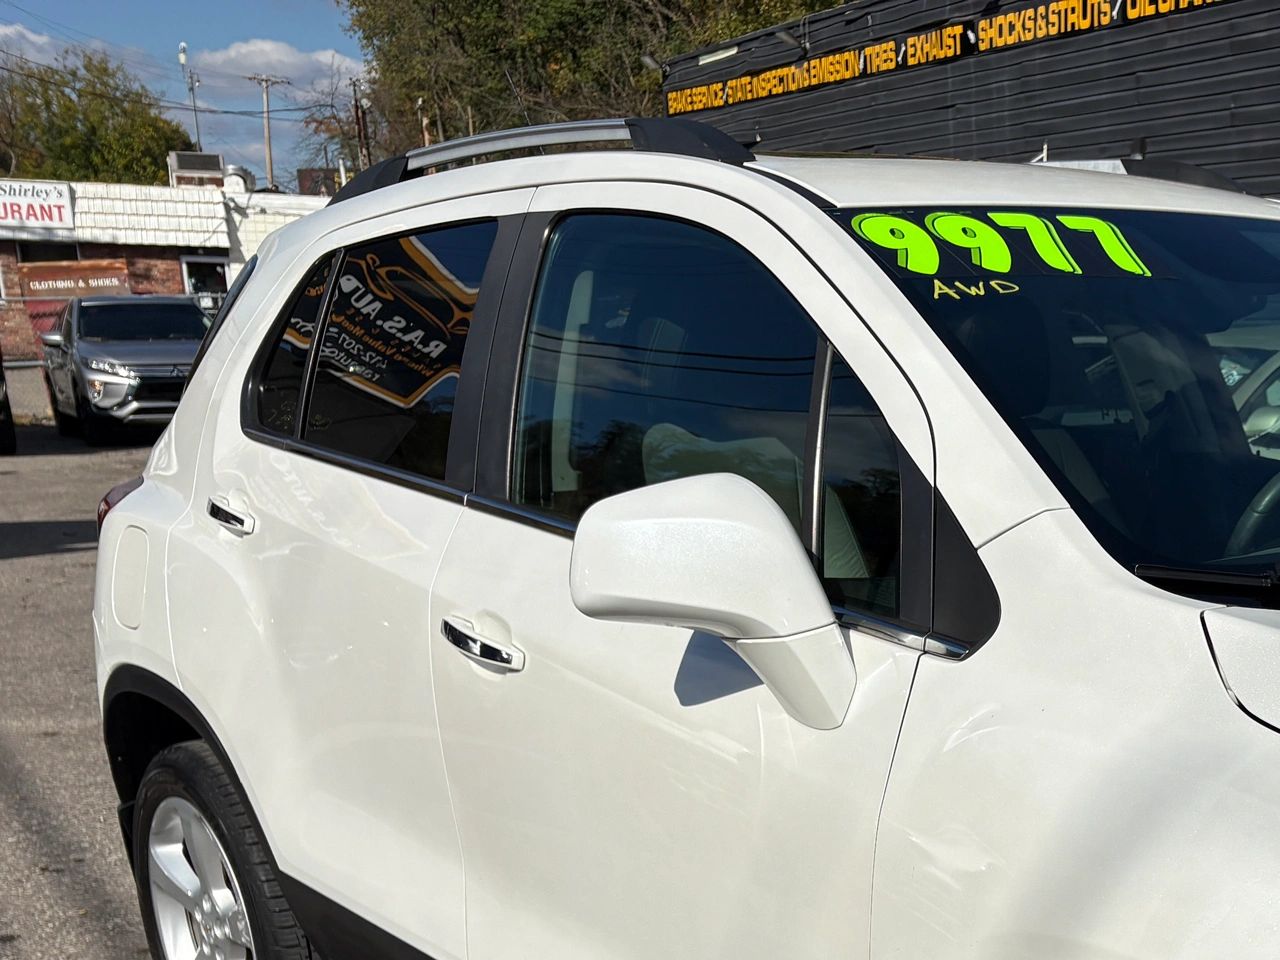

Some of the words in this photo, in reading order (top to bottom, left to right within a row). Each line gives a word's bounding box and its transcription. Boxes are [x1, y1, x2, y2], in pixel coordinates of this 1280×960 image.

[810, 51, 860, 86] EMISSION
[864, 40, 897, 75] TIRES
[907, 25, 963, 66] EXHAUST
[978, 6, 1034, 51] SHOCKS
[0, 184, 63, 201] Shirley's
[851, 211, 1152, 277] 9977
[933, 279, 1020, 300] AWD
